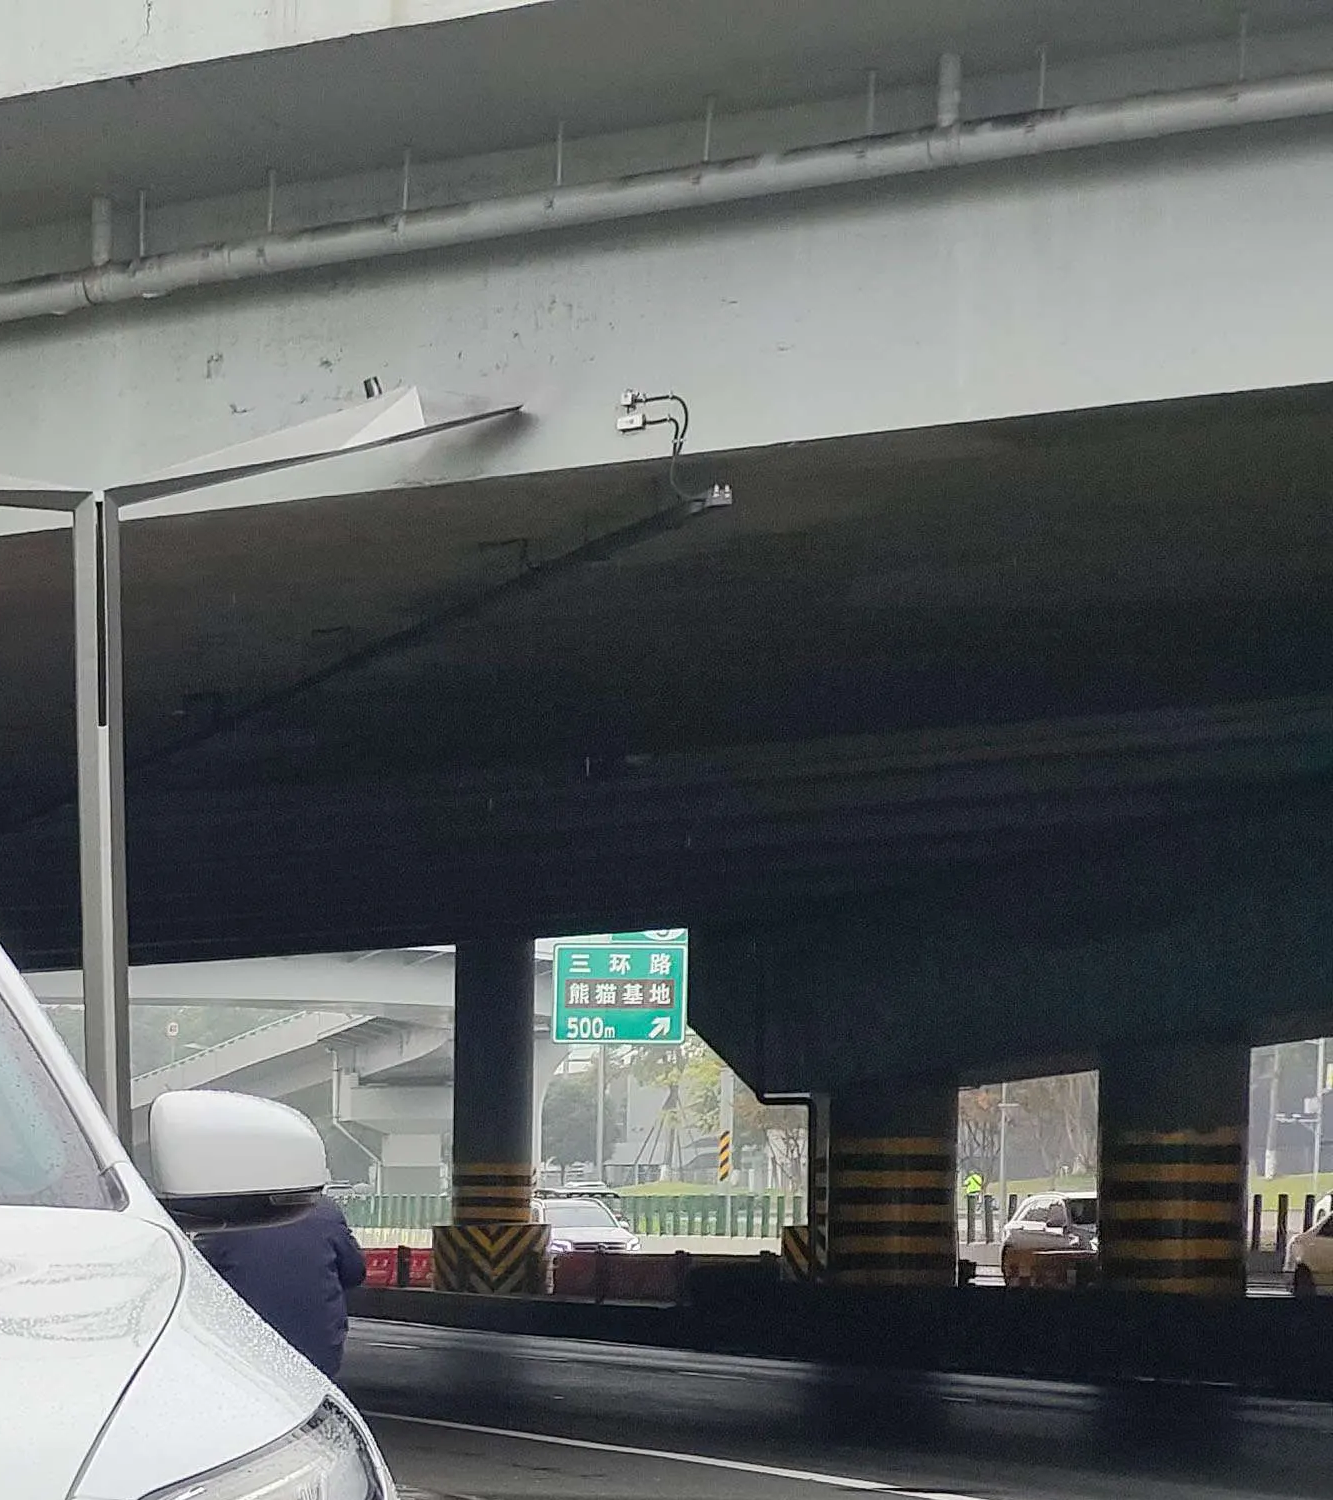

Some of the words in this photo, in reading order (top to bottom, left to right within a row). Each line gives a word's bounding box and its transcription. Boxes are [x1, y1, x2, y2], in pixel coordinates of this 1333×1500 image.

[569, 953, 672, 976] 三环路
[568, 982, 672, 1005] 熊猫基地
[566, 1017, 616, 1039] 500m
